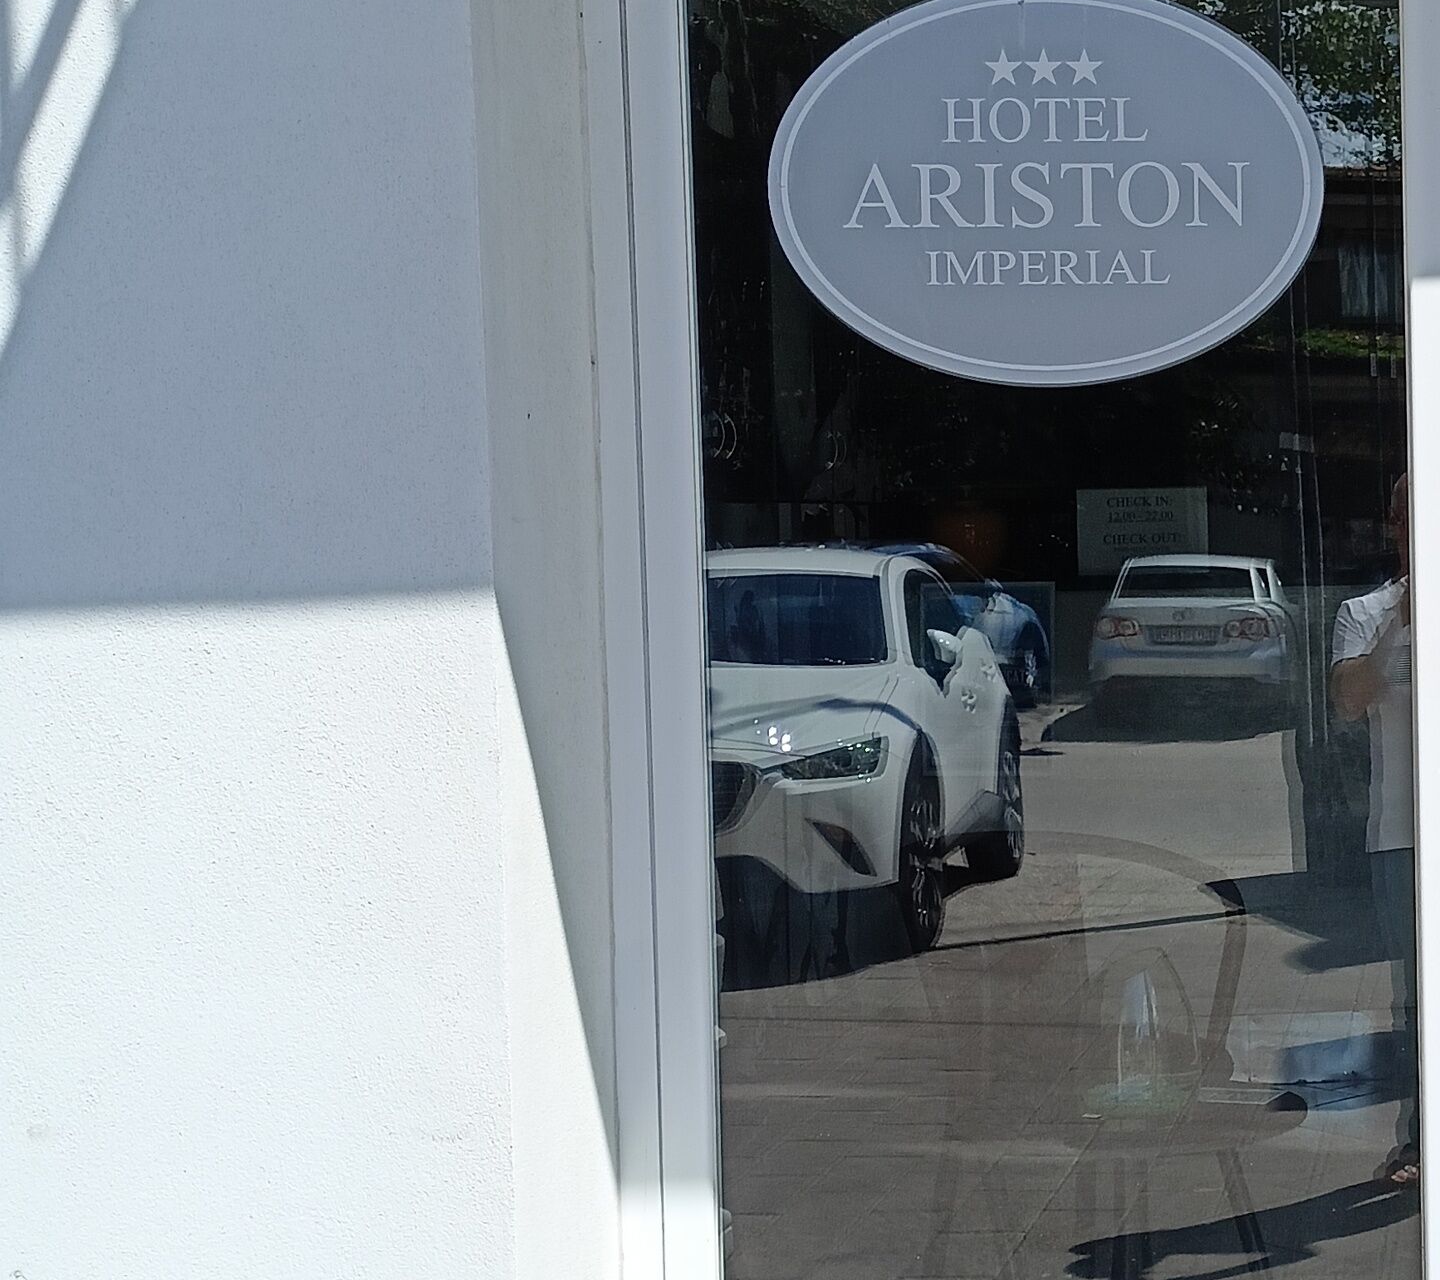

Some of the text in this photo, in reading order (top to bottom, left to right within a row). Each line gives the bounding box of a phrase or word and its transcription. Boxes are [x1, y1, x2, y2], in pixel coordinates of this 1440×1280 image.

[941, 96, 1149, 144] HOTEL
[842, 160, 1250, 229] ARISTON
[925, 249, 1171, 286] IMPERIAL
[1106, 496, 1152, 508] CHECK
[1103, 533, 1148, 545] CHECK
